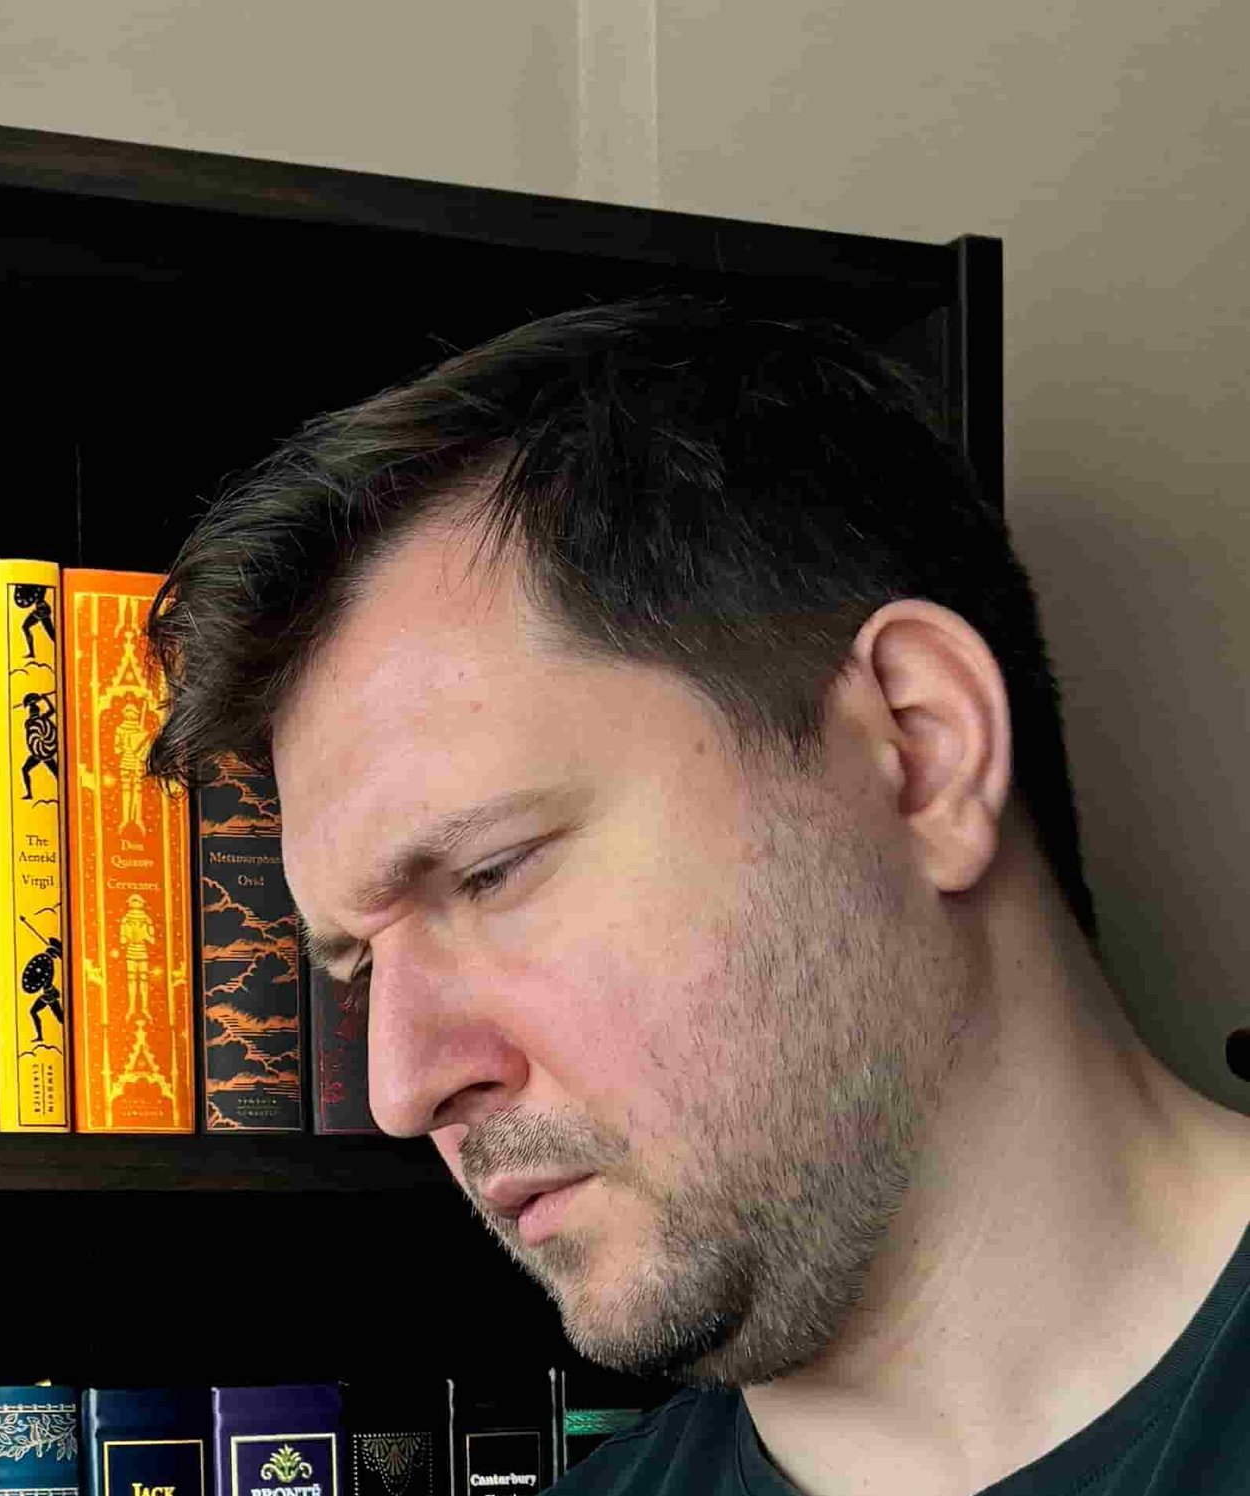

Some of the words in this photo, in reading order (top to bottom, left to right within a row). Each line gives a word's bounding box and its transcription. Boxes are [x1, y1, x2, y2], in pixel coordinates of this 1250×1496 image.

[26, 835, 49, 847] The
[120, 839, 144, 851] Don
[19, 852, 56, 864] Aeneid
[111, 855, 155, 869] Quixote
[22, 874, 55, 889] Virgil
[107, 879, 159, 892] Cervantes
[238, 875, 265, 887] Ovid
[470, 1473, 537, 1488] Canterbury
